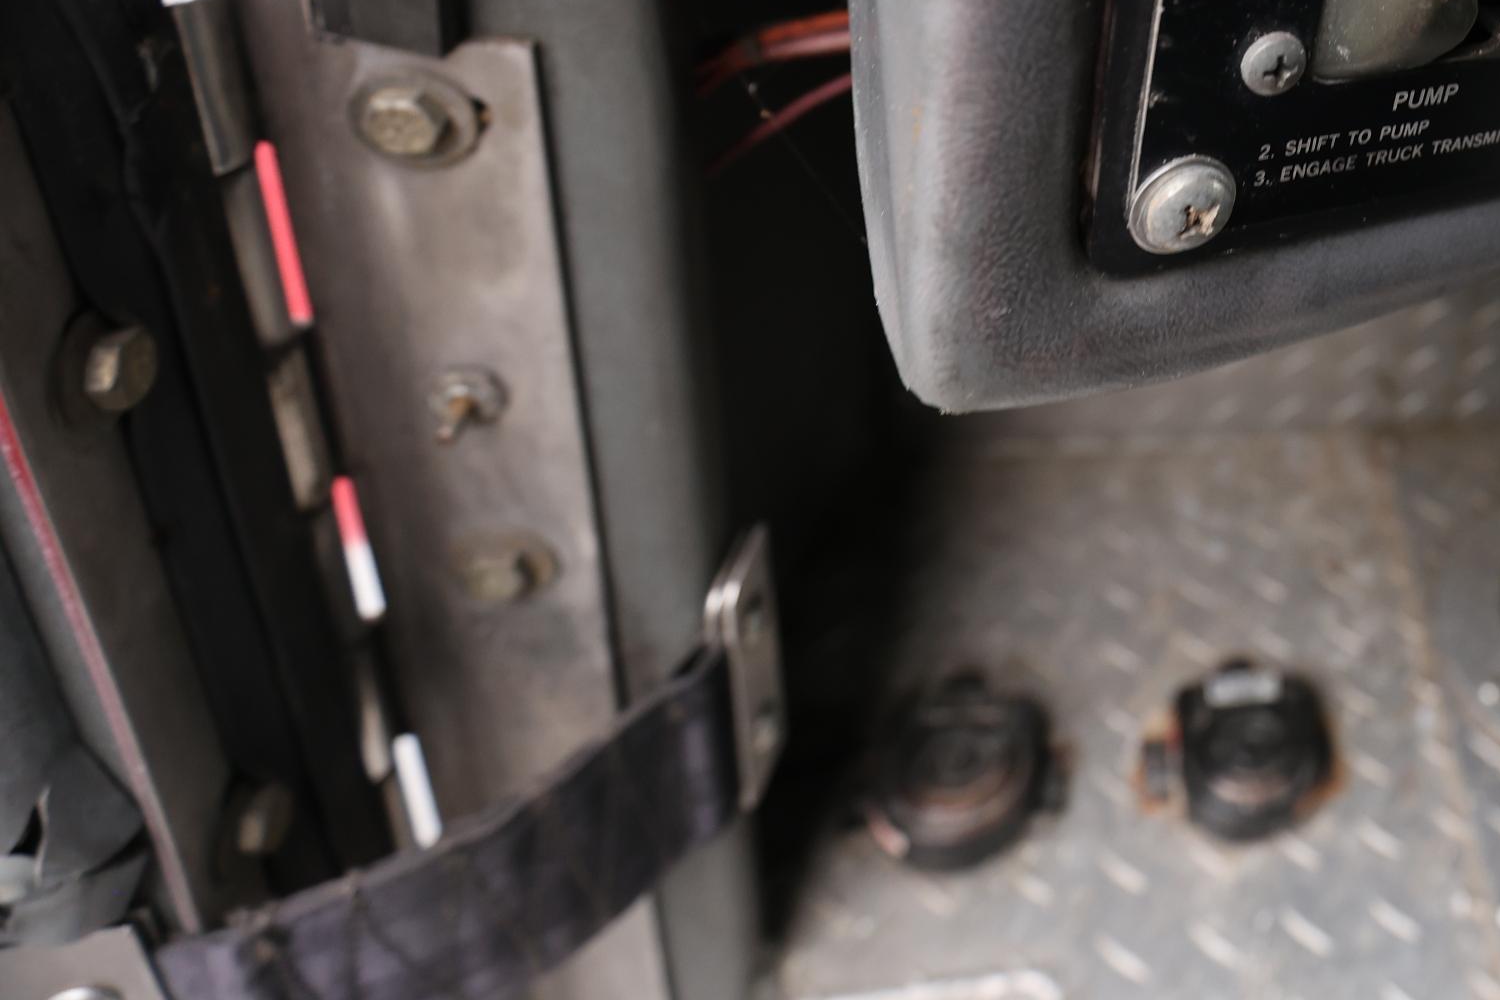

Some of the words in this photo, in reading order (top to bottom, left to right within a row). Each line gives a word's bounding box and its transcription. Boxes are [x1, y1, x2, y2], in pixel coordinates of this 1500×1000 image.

[1392, 83, 1460, 112] PUMP
[1258, 144, 1275, 161] 2.
[1284, 132, 1341, 158] SHIFT
[1347, 128, 1372, 147] TO
[1379, 119, 1430, 141] PUMP
[1279, 154, 1358, 183] ENGAGE
[1365, 143, 1424, 168] TRUCK
